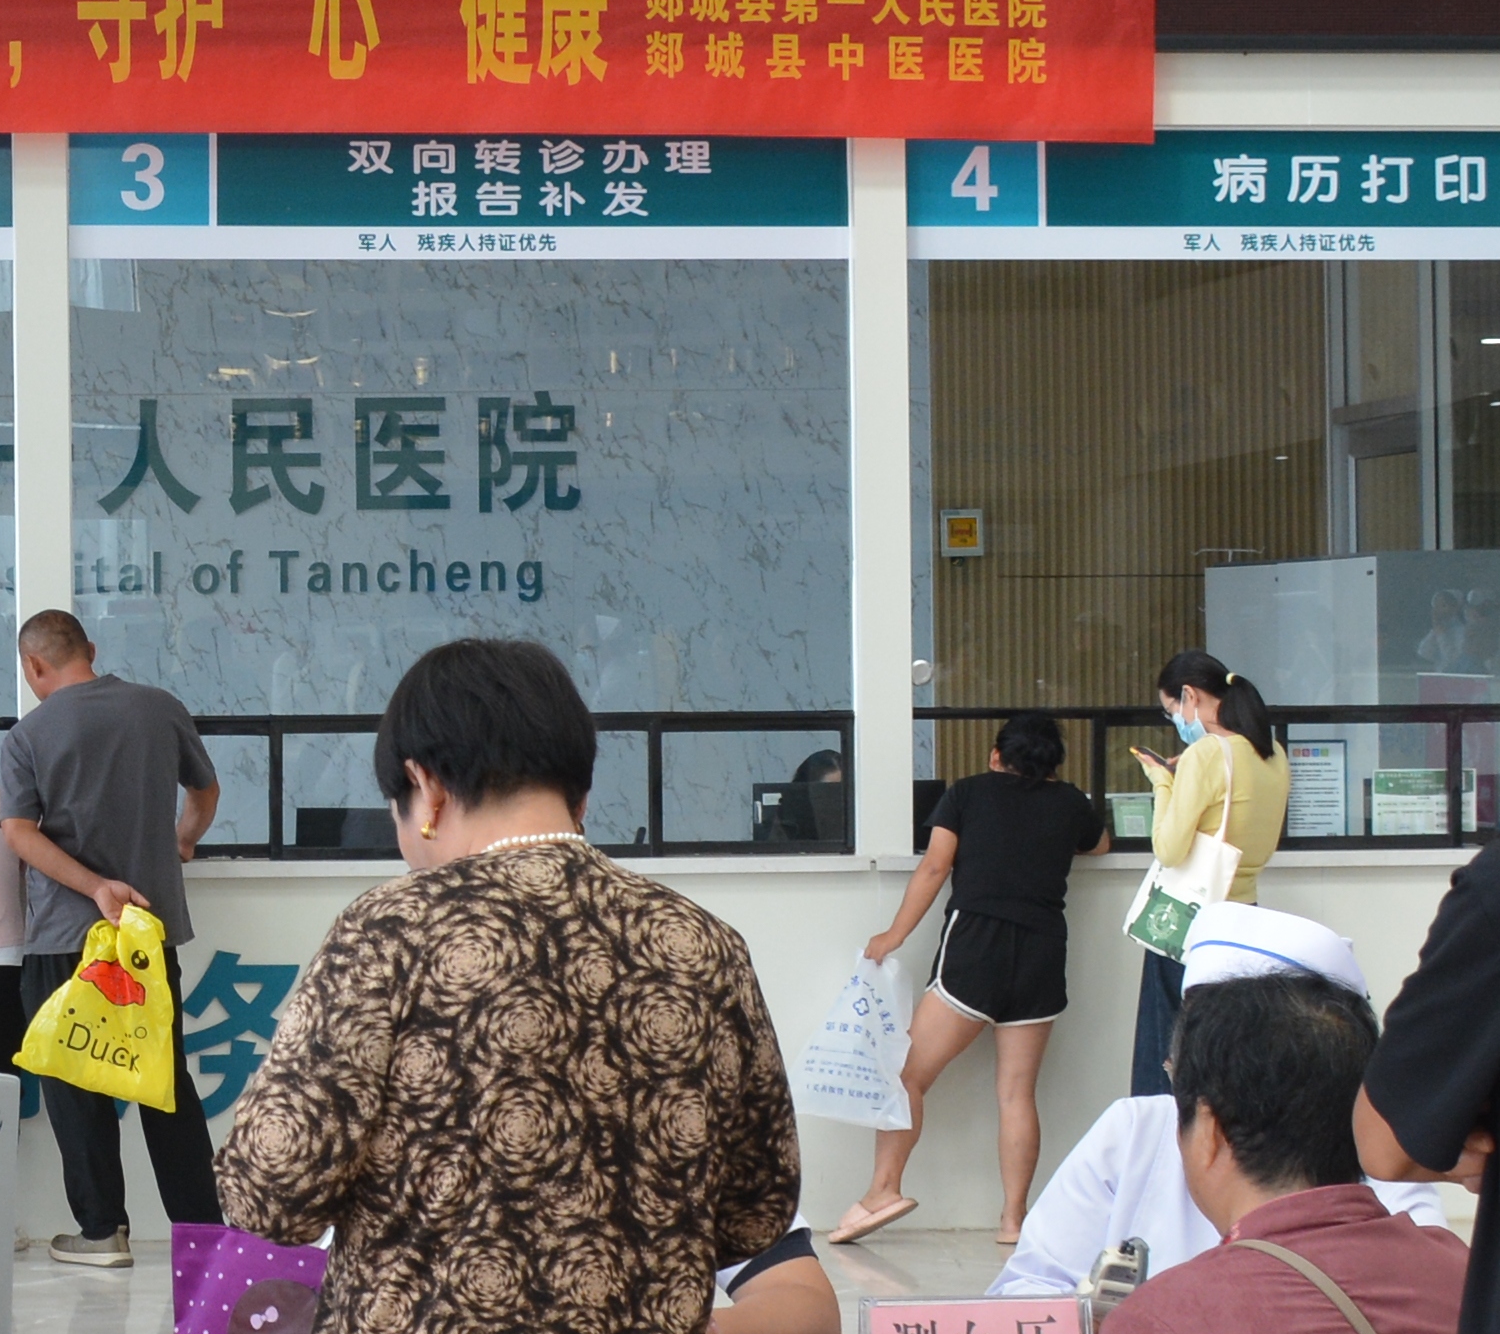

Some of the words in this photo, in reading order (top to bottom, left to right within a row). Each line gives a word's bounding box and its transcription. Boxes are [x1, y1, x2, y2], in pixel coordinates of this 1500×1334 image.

[645, 31, 1048, 86] 郯城县中医医院
[119, 142, 167, 210] 3
[348, 140, 711, 174] 双向转诊办理
[950, 146, 1000, 210] 4
[1213, 154, 1486, 203] 病历打印
[412, 181, 648, 216] 报告补发
[359, 234, 396, 251] 军人
[418, 234, 556, 251] 残疾人持证优先
[1184, 234, 1220, 251] 军人
[1241, 234, 1375, 251] 残疾人持证优先
[192, 549, 245, 596] of
[269, 549, 546, 603] Tancheng
[66, 1021, 141, 1074] Duck
